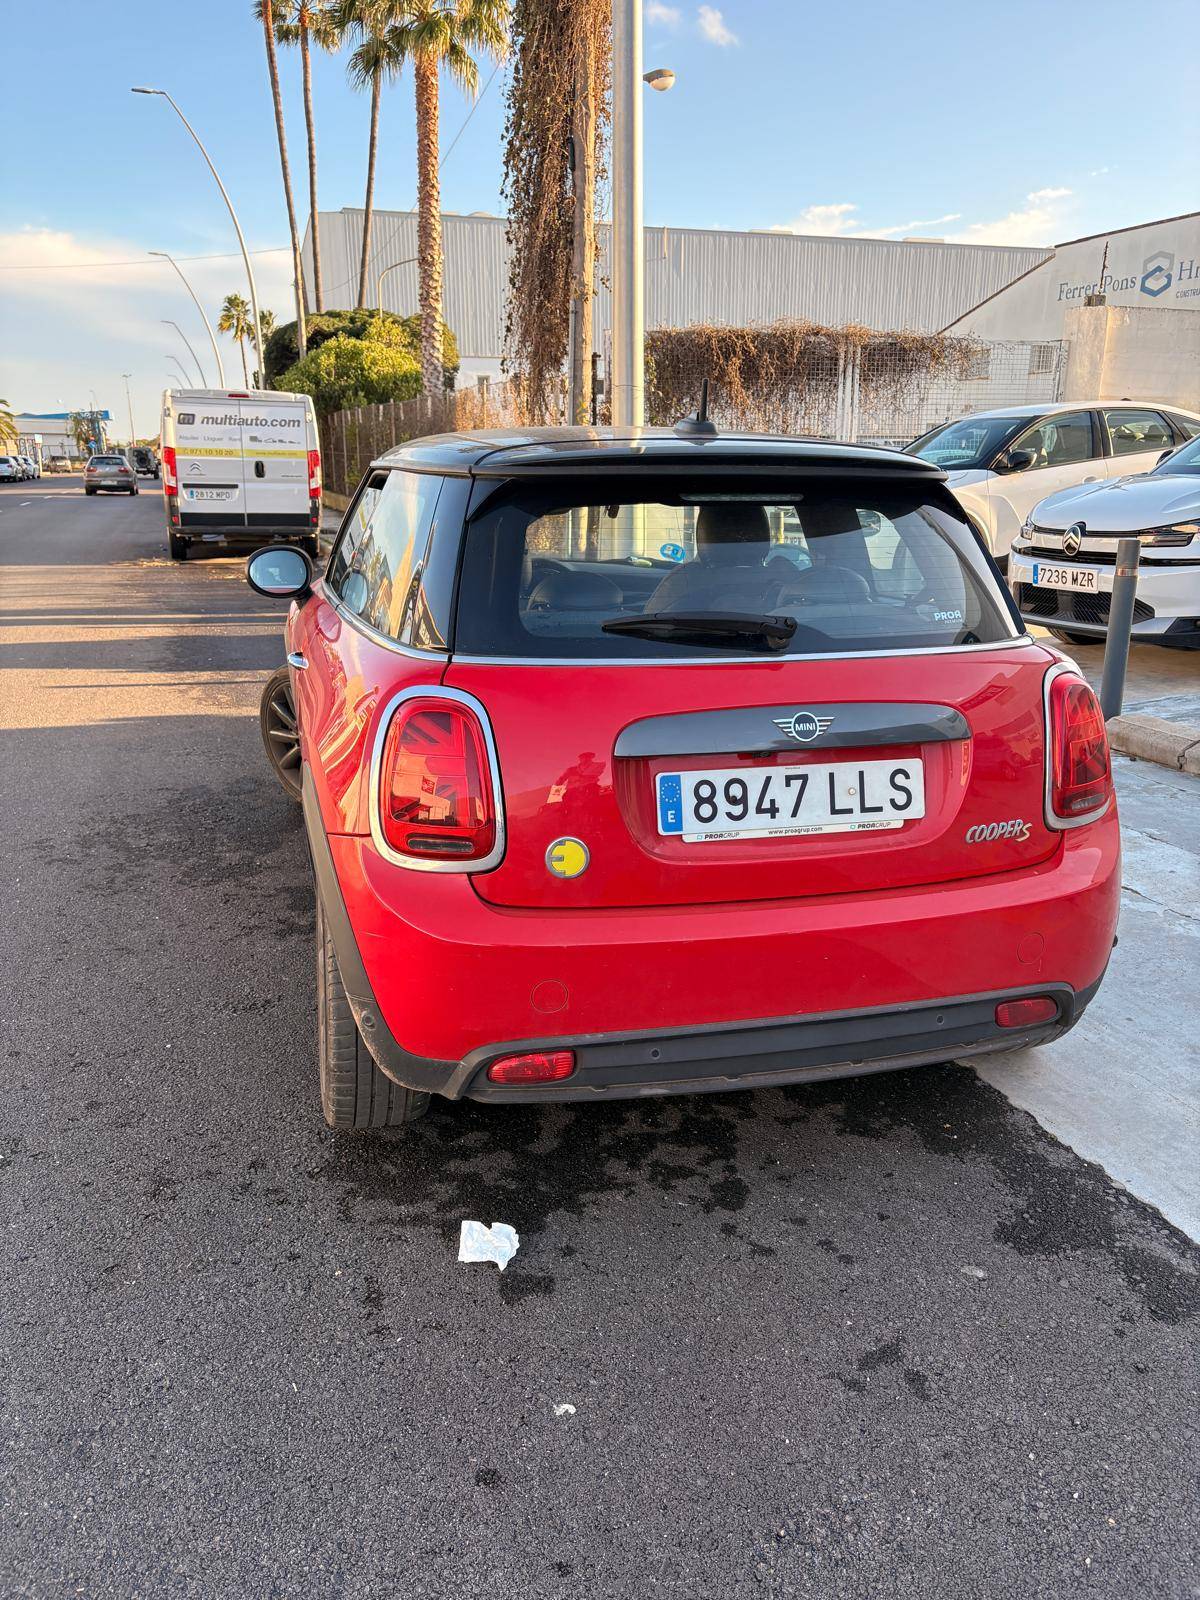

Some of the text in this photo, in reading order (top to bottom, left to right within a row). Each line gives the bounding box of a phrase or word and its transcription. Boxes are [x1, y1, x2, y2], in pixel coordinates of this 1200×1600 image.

[1057, 274, 1137, 301] Ferrer Pons
[201, 414, 300, 428] multiauto.com
[1040, 568, 1094, 588] 7236 MZR
[934, 610, 961, 621] PROA
[795, 722, 816, 731] MINI
[693, 768, 913, 824] 8947 LLS
[667, 810, 676, 823] E
[768, 827, 823, 835] www.proagrup.com
[857, 821, 892, 829] PROAGRUP
[704, 831, 740, 840] PROAGRUP
